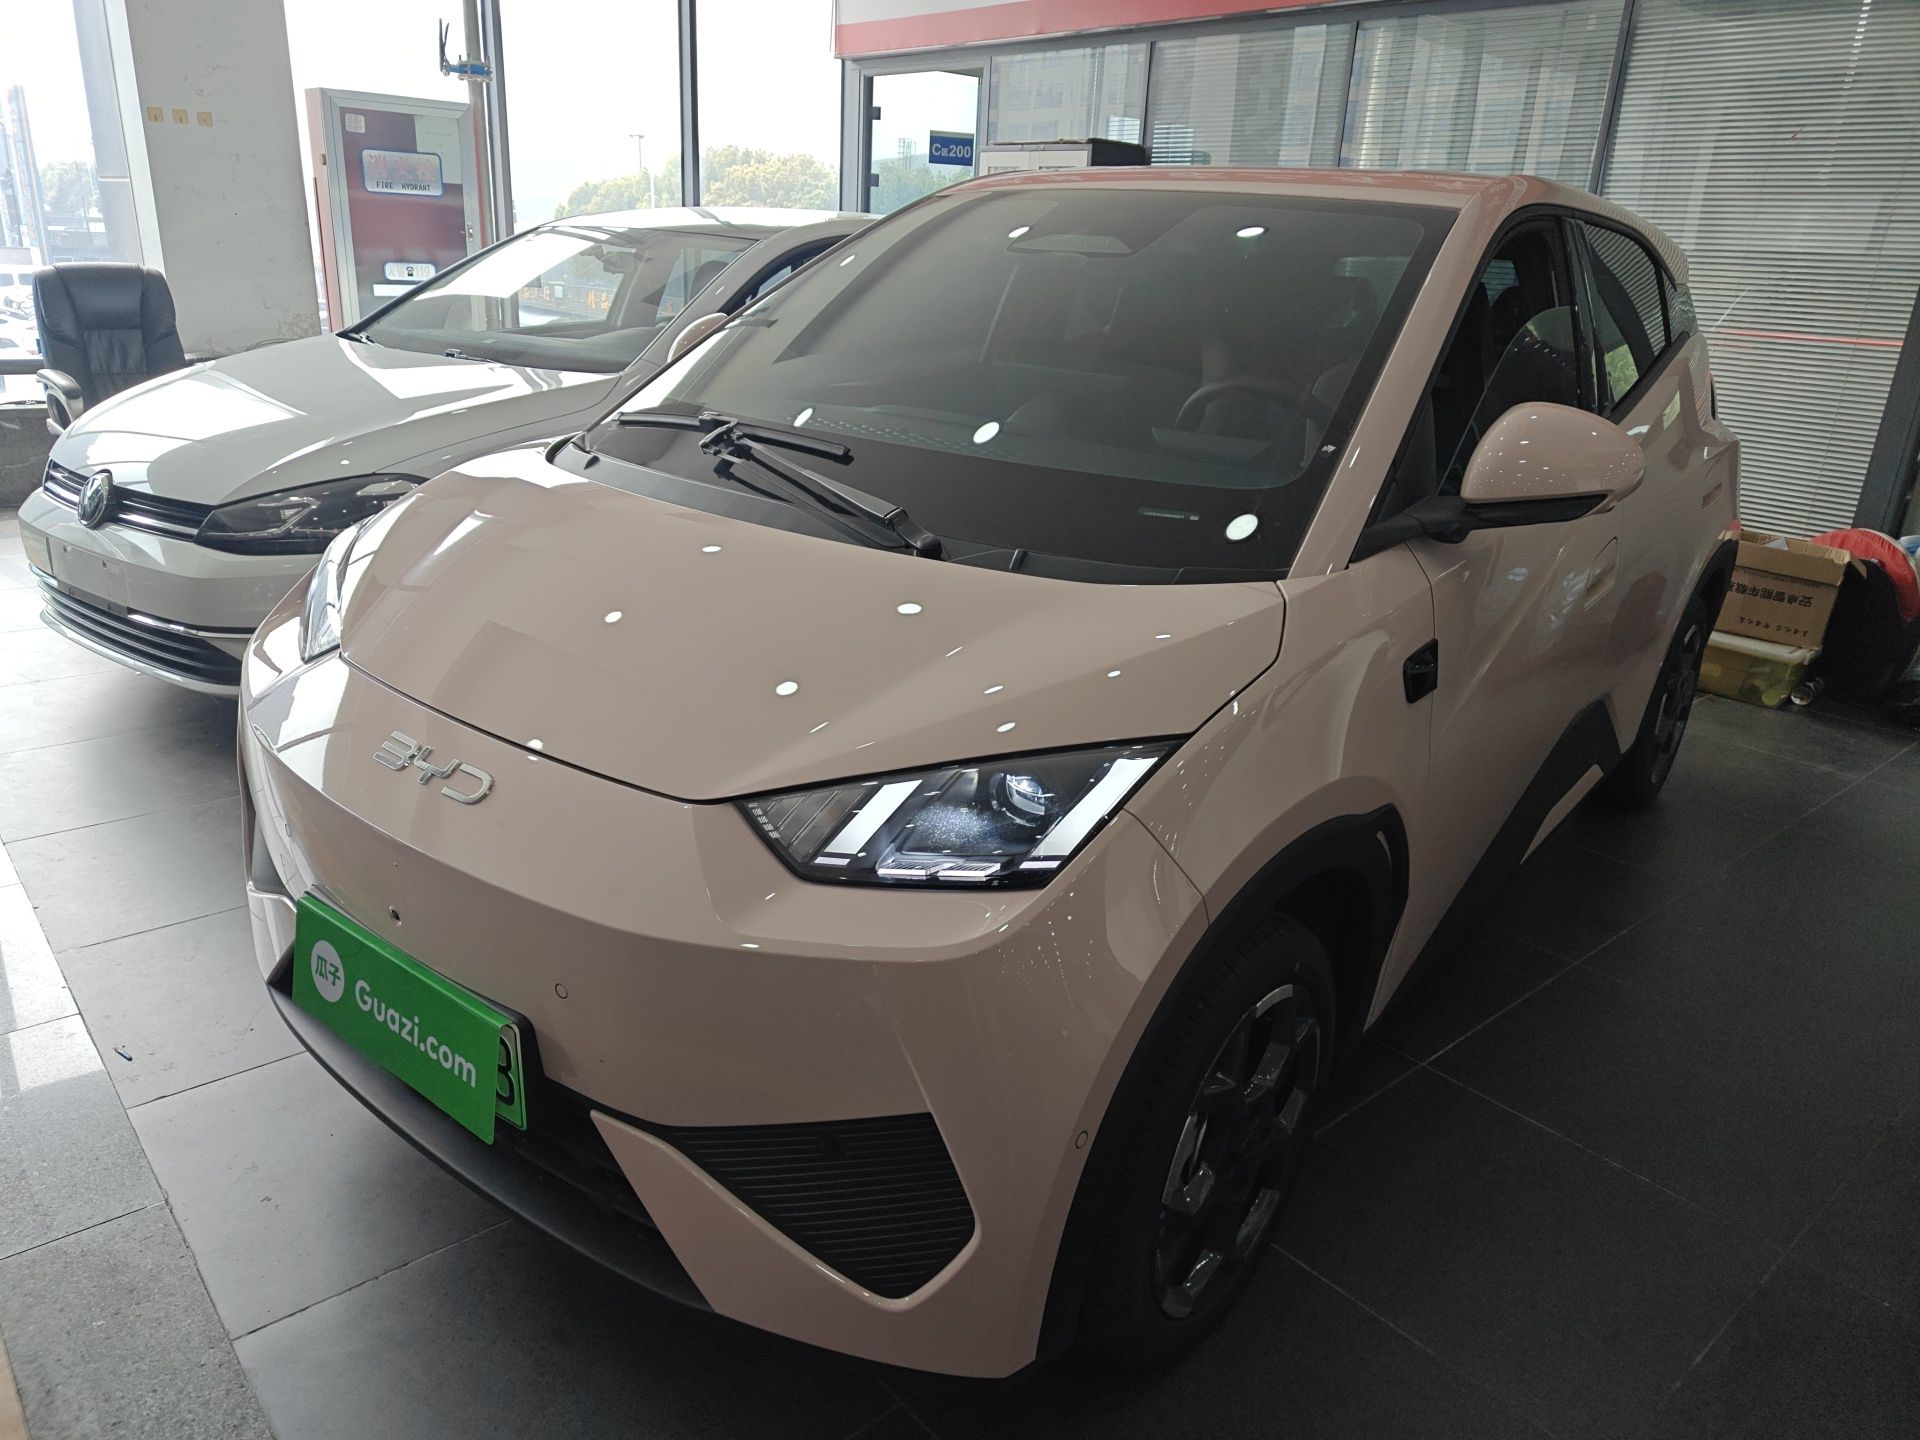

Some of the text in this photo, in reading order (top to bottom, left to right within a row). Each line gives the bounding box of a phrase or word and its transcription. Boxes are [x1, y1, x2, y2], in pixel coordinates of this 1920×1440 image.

[376, 181, 431, 192] FIRE HYDRANT
[372, 730, 494, 805] BYD
[315, 954, 341, 986] 瓜子
[355, 979, 476, 1089] Guazi.com
